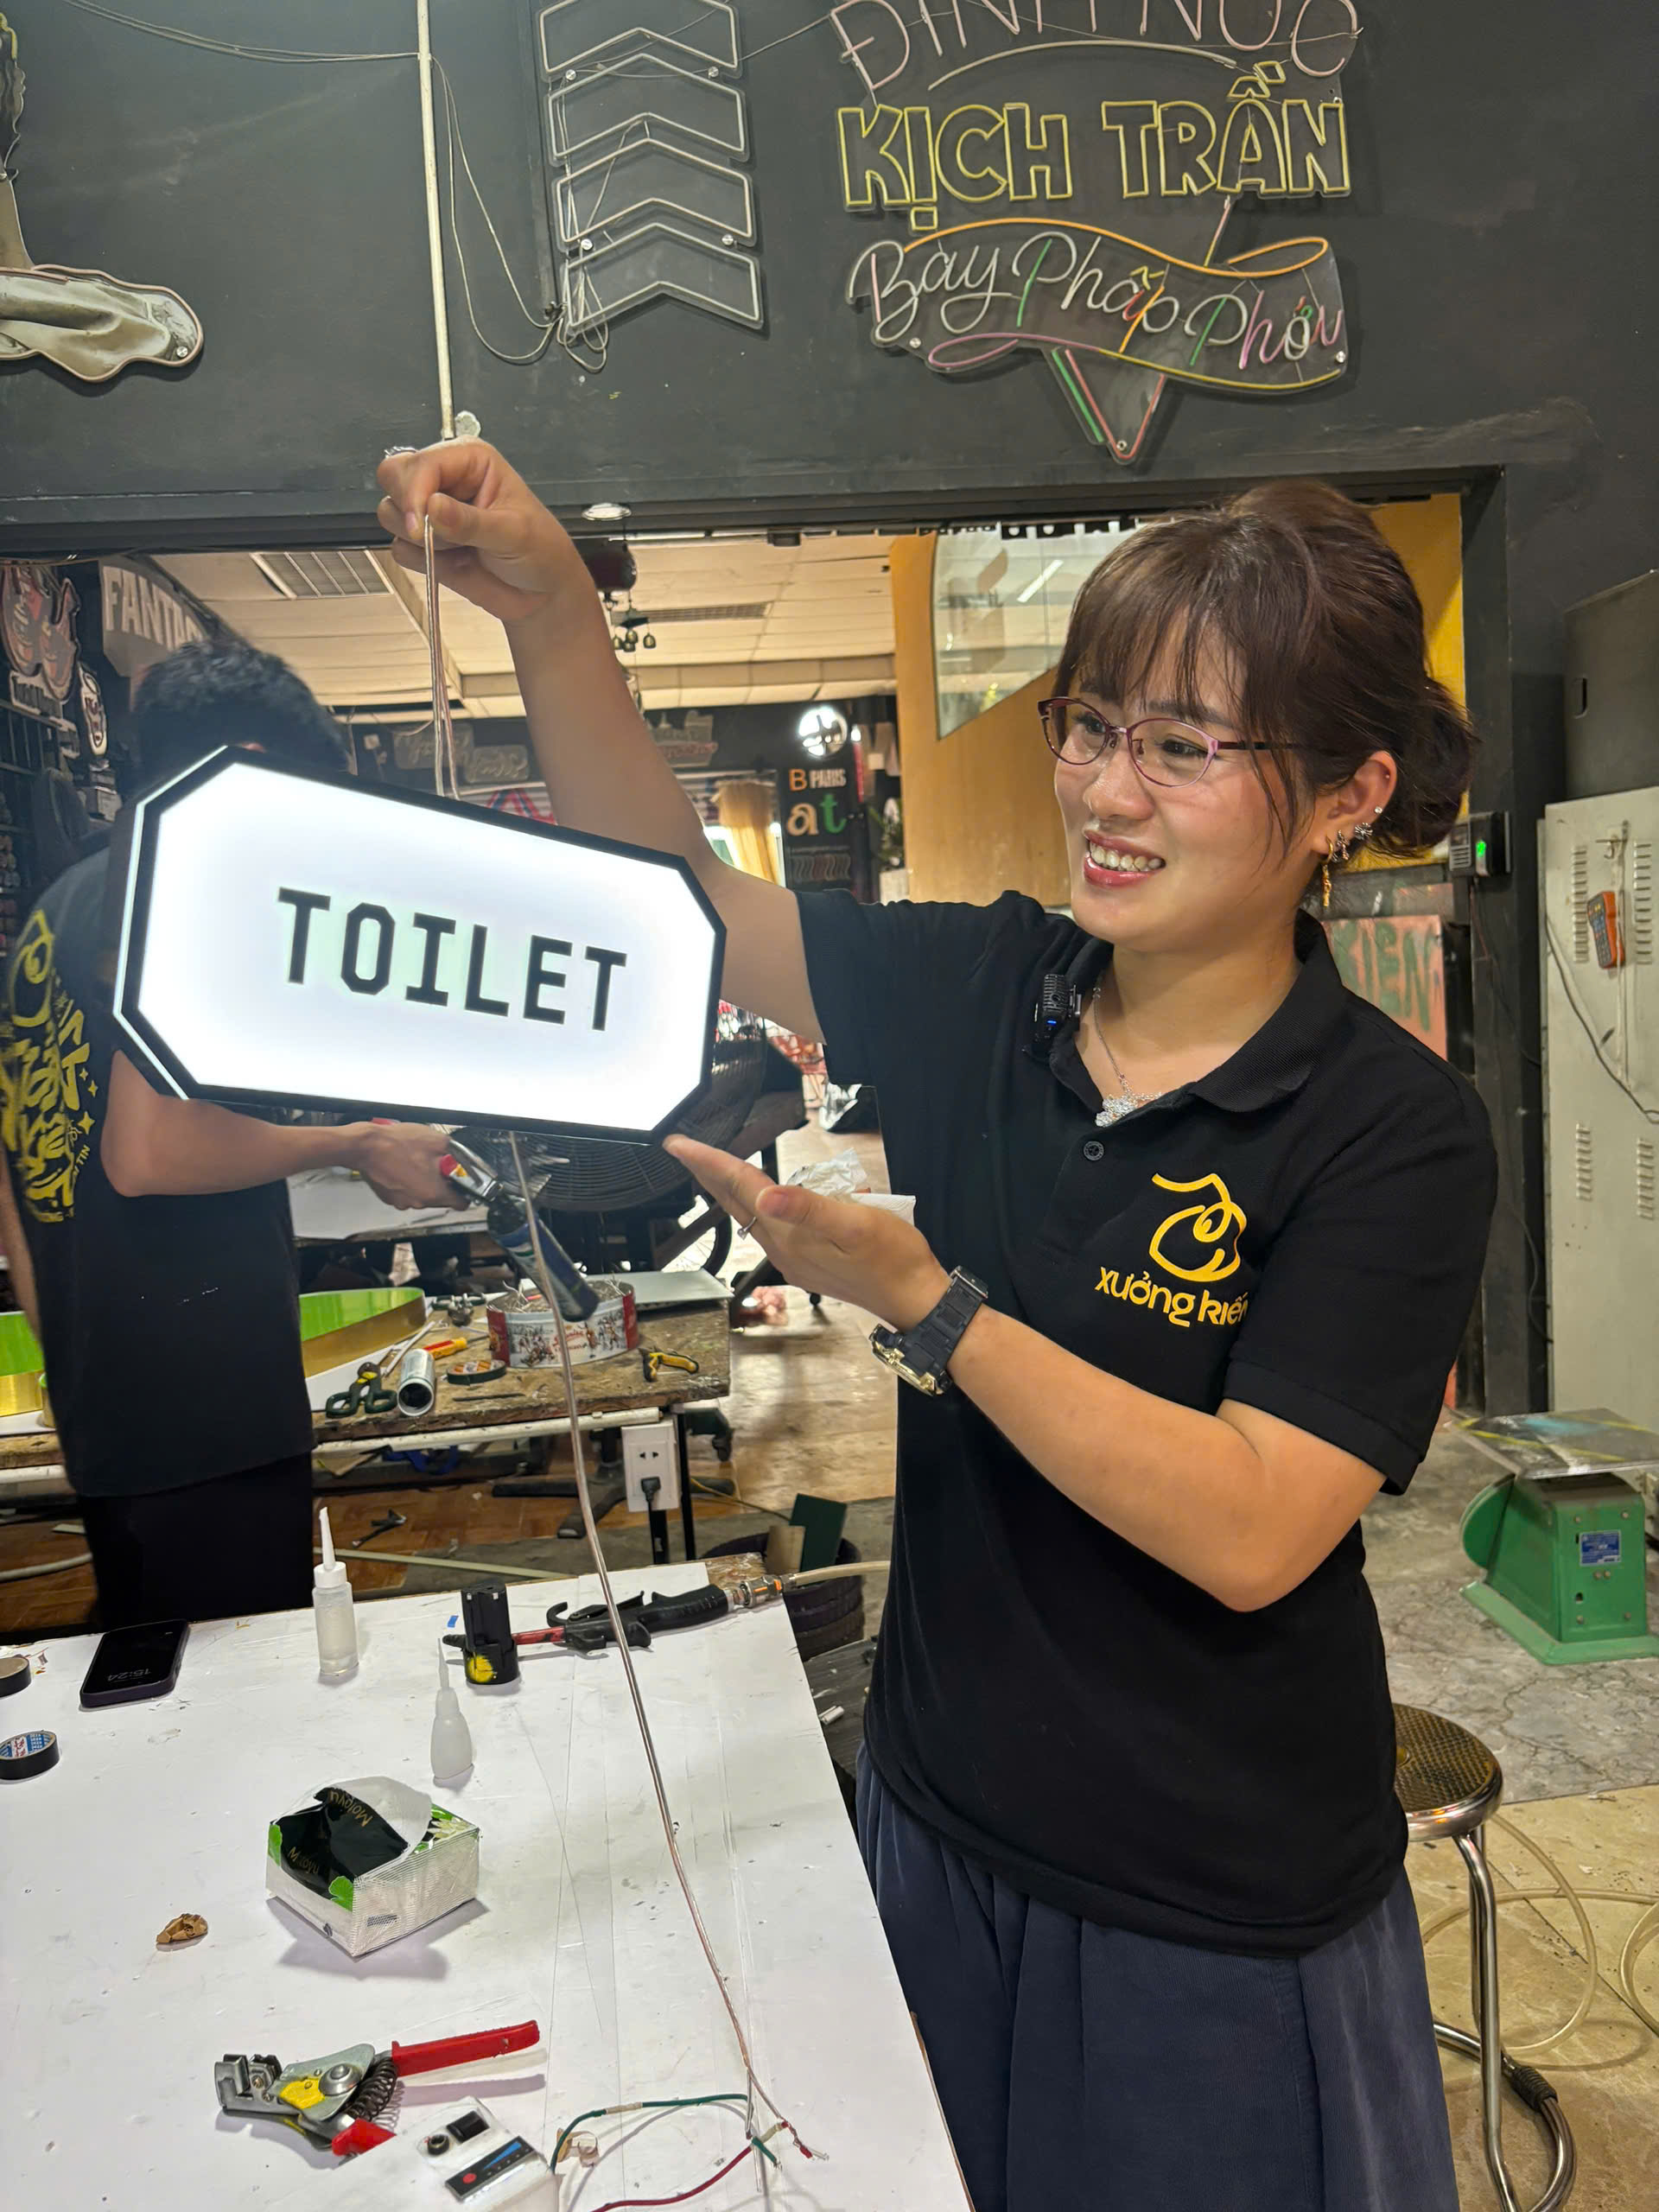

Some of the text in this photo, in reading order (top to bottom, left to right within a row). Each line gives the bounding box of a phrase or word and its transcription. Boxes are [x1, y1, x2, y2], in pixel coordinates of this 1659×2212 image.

[836, 60, 1351, 232] KỊCH TRẦN
[845, 240, 1013, 344] Bay
[789, 767, 808, 791] B
[277, 886, 628, 1032] TOILET
[1094, 1266, 1196, 1328] xưởng
[107, 1668, 150, 1681] 15:24
